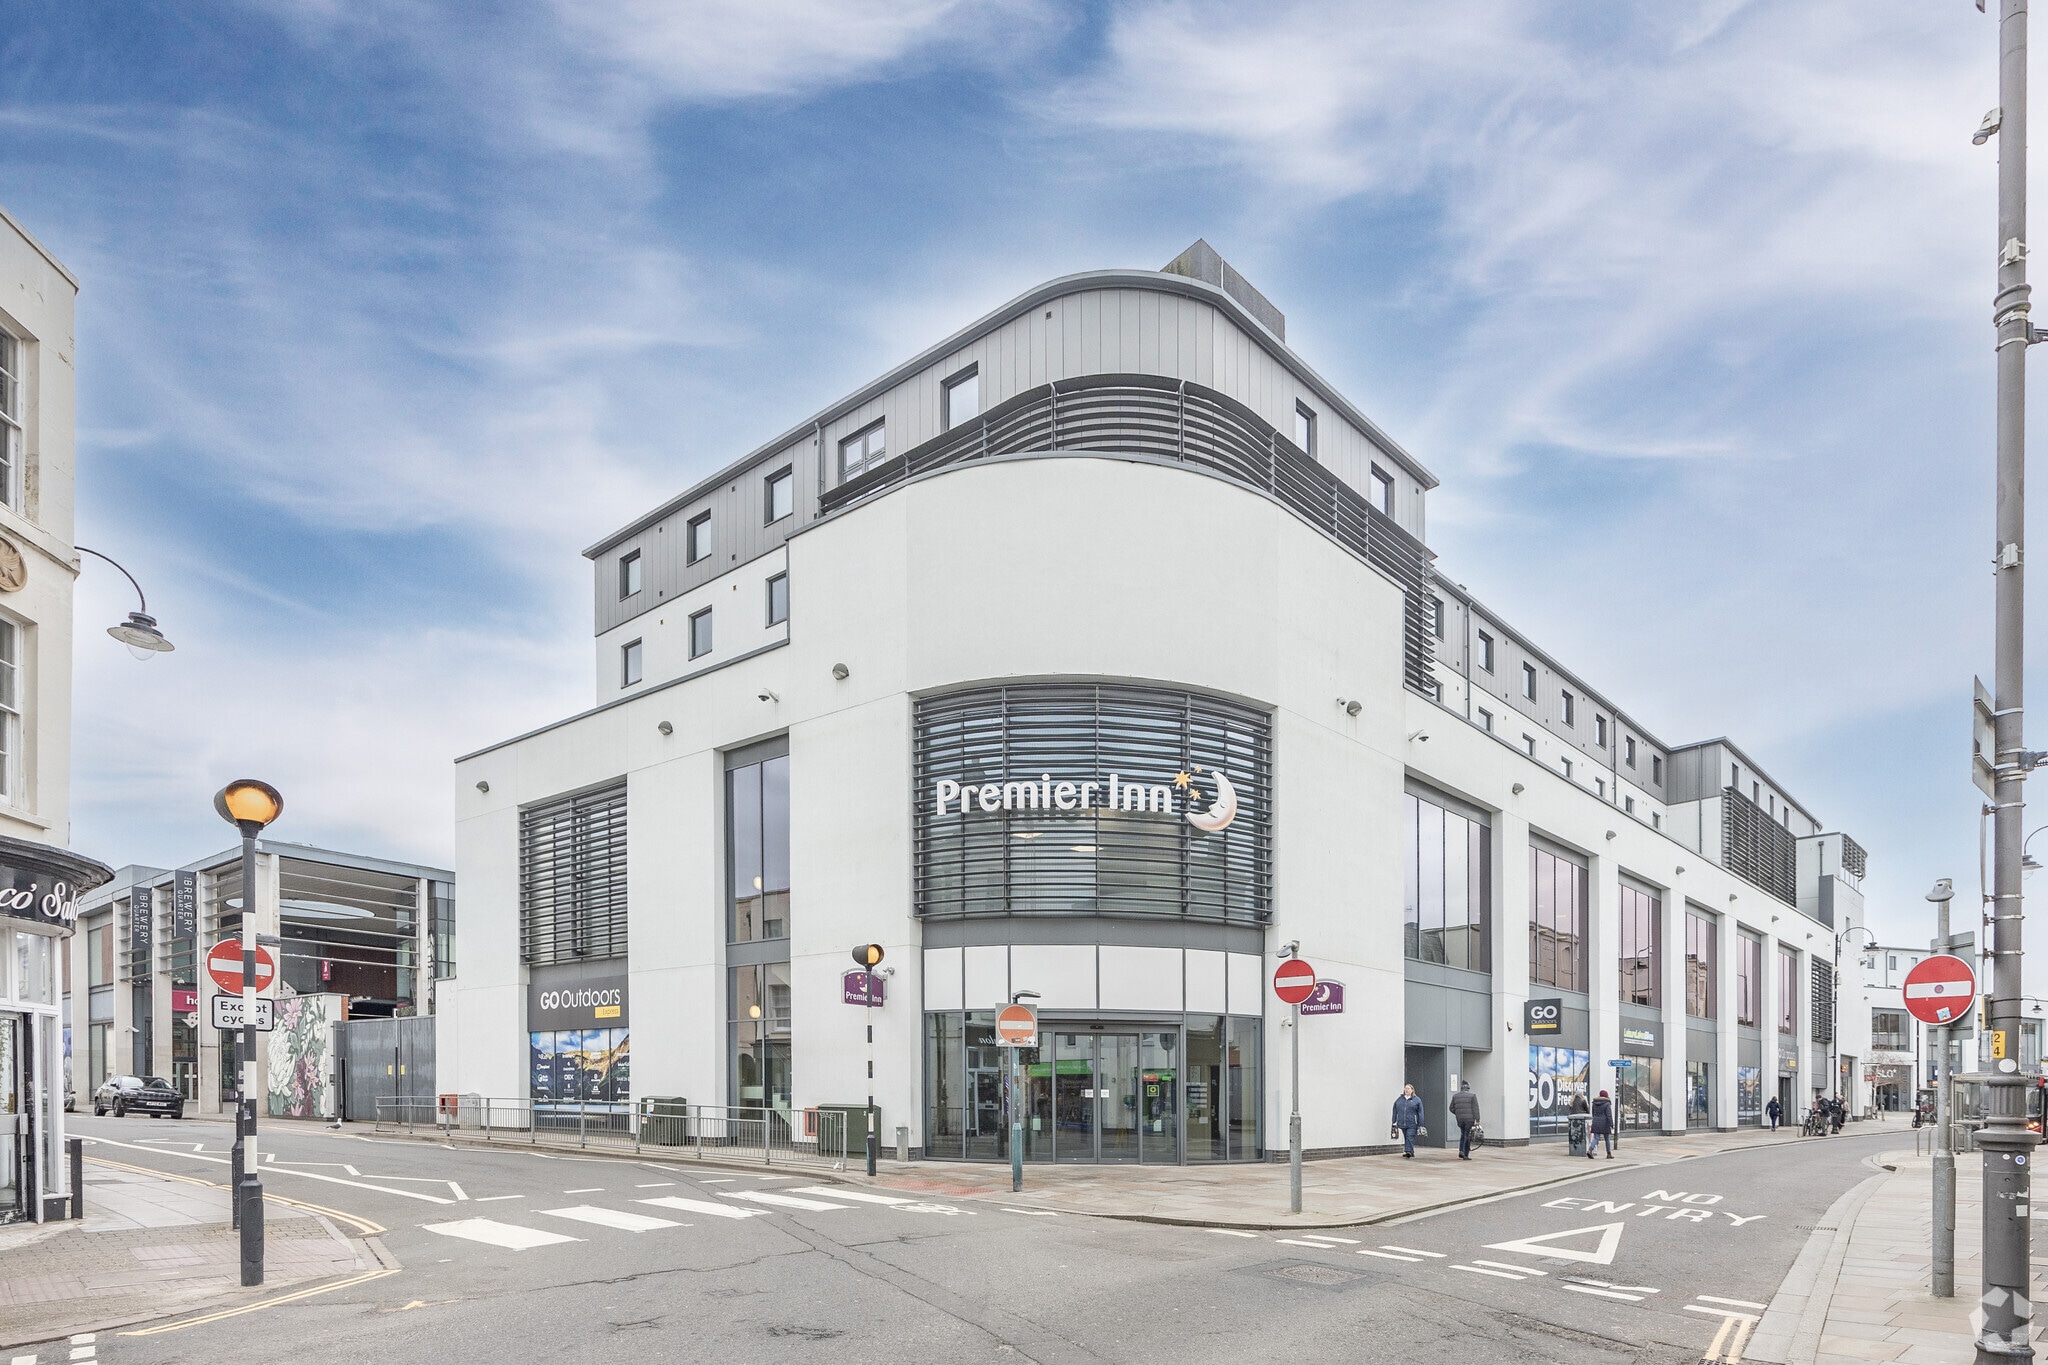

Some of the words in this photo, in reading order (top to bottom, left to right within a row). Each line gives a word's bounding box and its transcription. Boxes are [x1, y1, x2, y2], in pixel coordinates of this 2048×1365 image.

[936, 773, 1099, 816] Premier
[1109, 773, 1173, 814] Inn
[184, 880, 192, 933] BREWERY
[139, 895, 148, 945] BREWERY
[540, 991, 560, 1010] GO
[561, 988, 621, 1008] Outdoors
[845, 990, 868, 1002] Premie
[871, 994, 882, 1003] Inn
[220, 1000, 267, 1014] Exct
[1302, 1003, 1330, 1012] Premier
[1330, 1002, 1342, 1010] Inn
[1530, 1005, 1558, 1020] GO
[222, 1015, 265, 1025] cycs
[1528, 1071, 1554, 1109] GO
[1557, 1079, 1588, 1093] Discover
[1557, 1092, 1572, 1106] Free
[1641, 1189, 1724, 1205] NO
[1540, 1196, 1768, 1227] ENTRY
